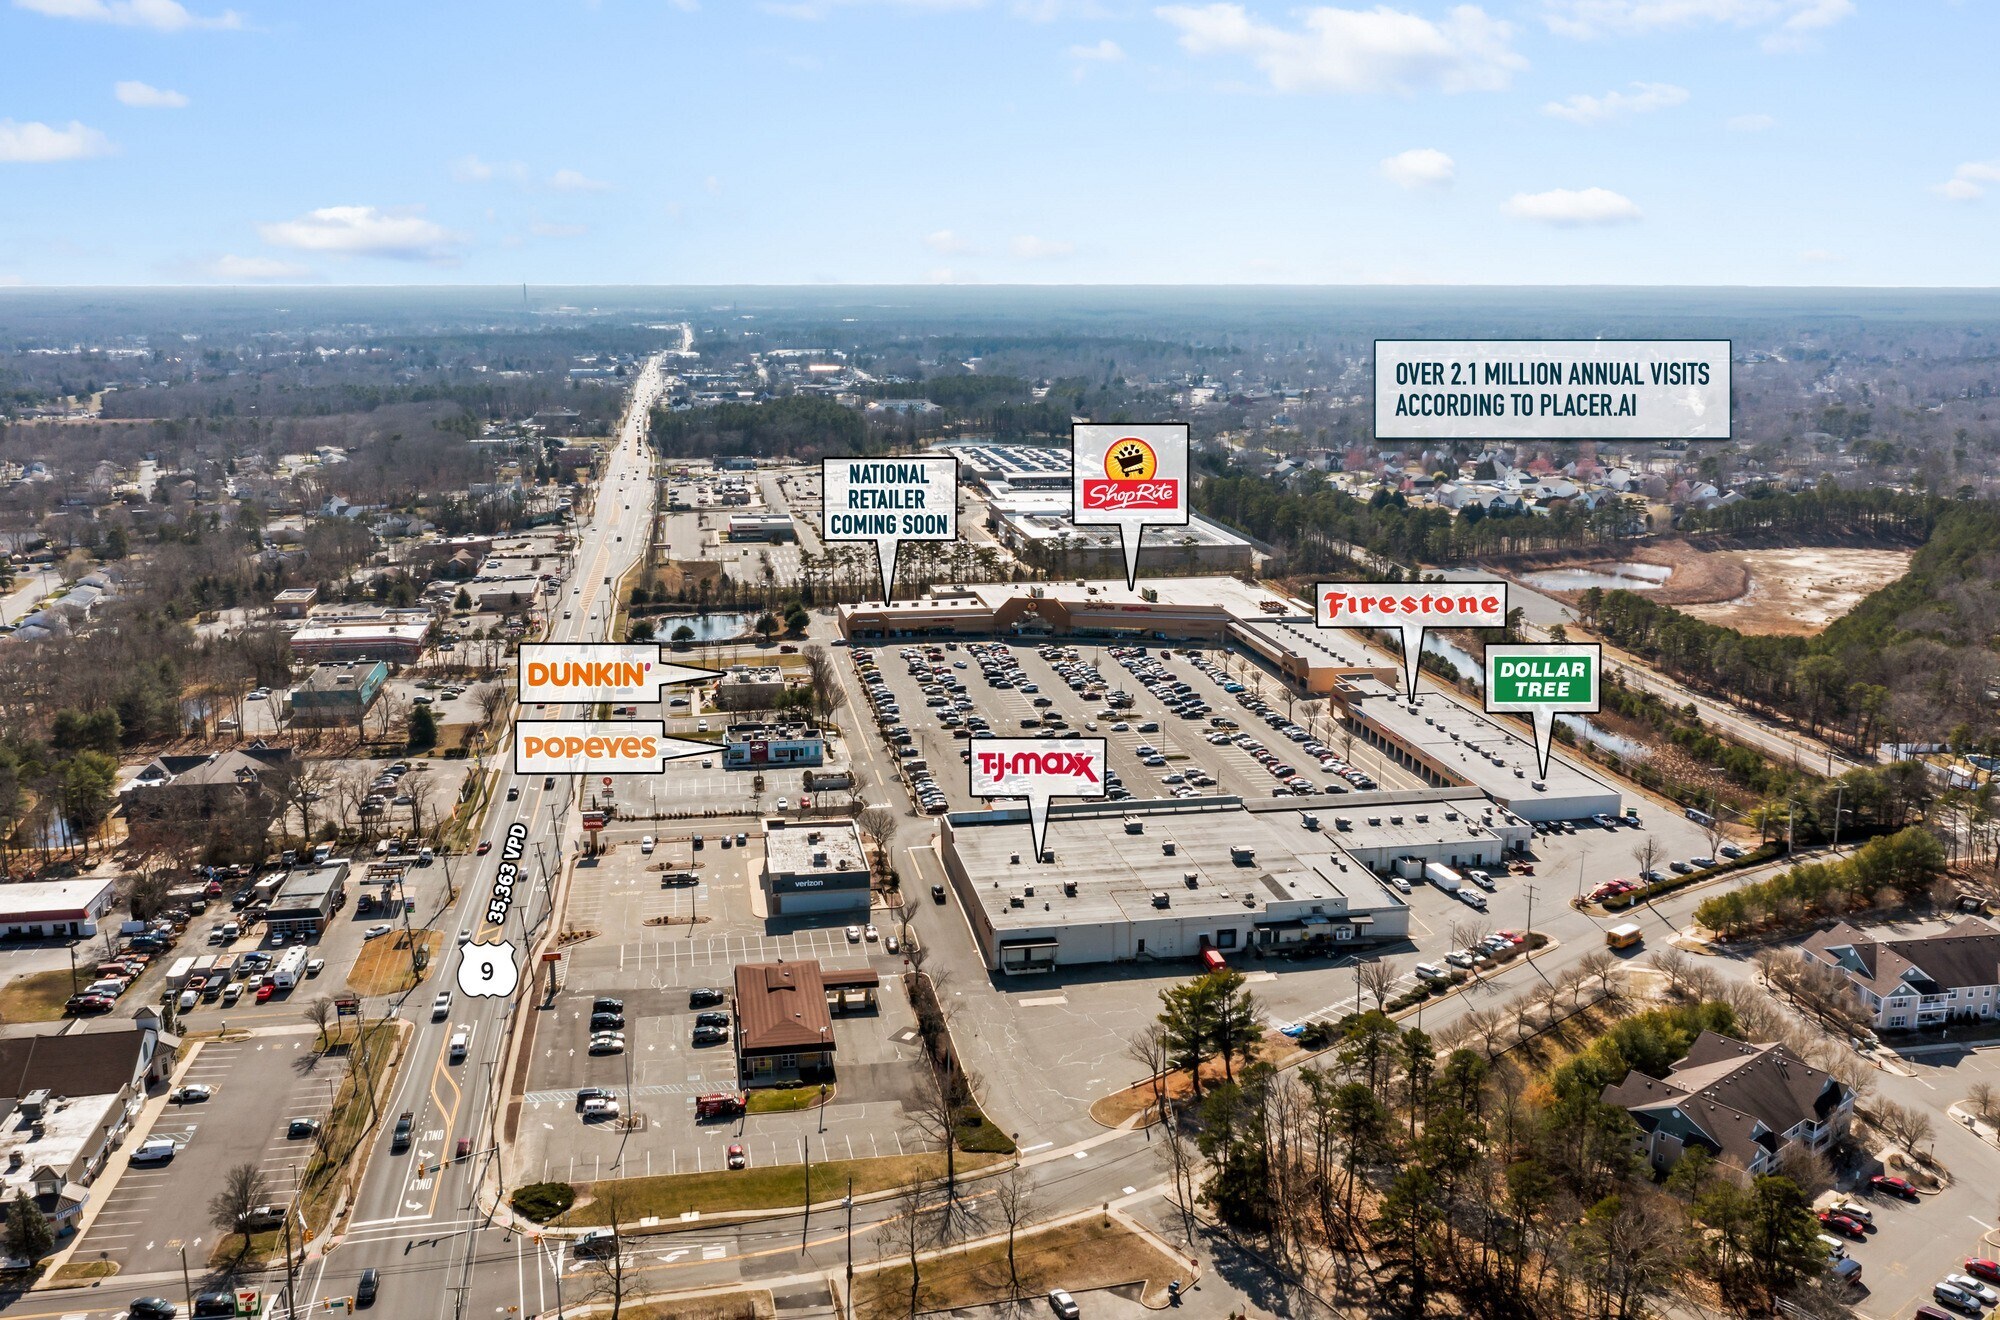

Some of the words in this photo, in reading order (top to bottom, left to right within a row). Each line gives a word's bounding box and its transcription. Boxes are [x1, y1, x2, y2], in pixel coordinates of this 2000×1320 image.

[422, 1130, 444, 1141] ONLY
[409, 1178, 432, 1191] ONLY
[240, 1292, 256, 1312] 7
